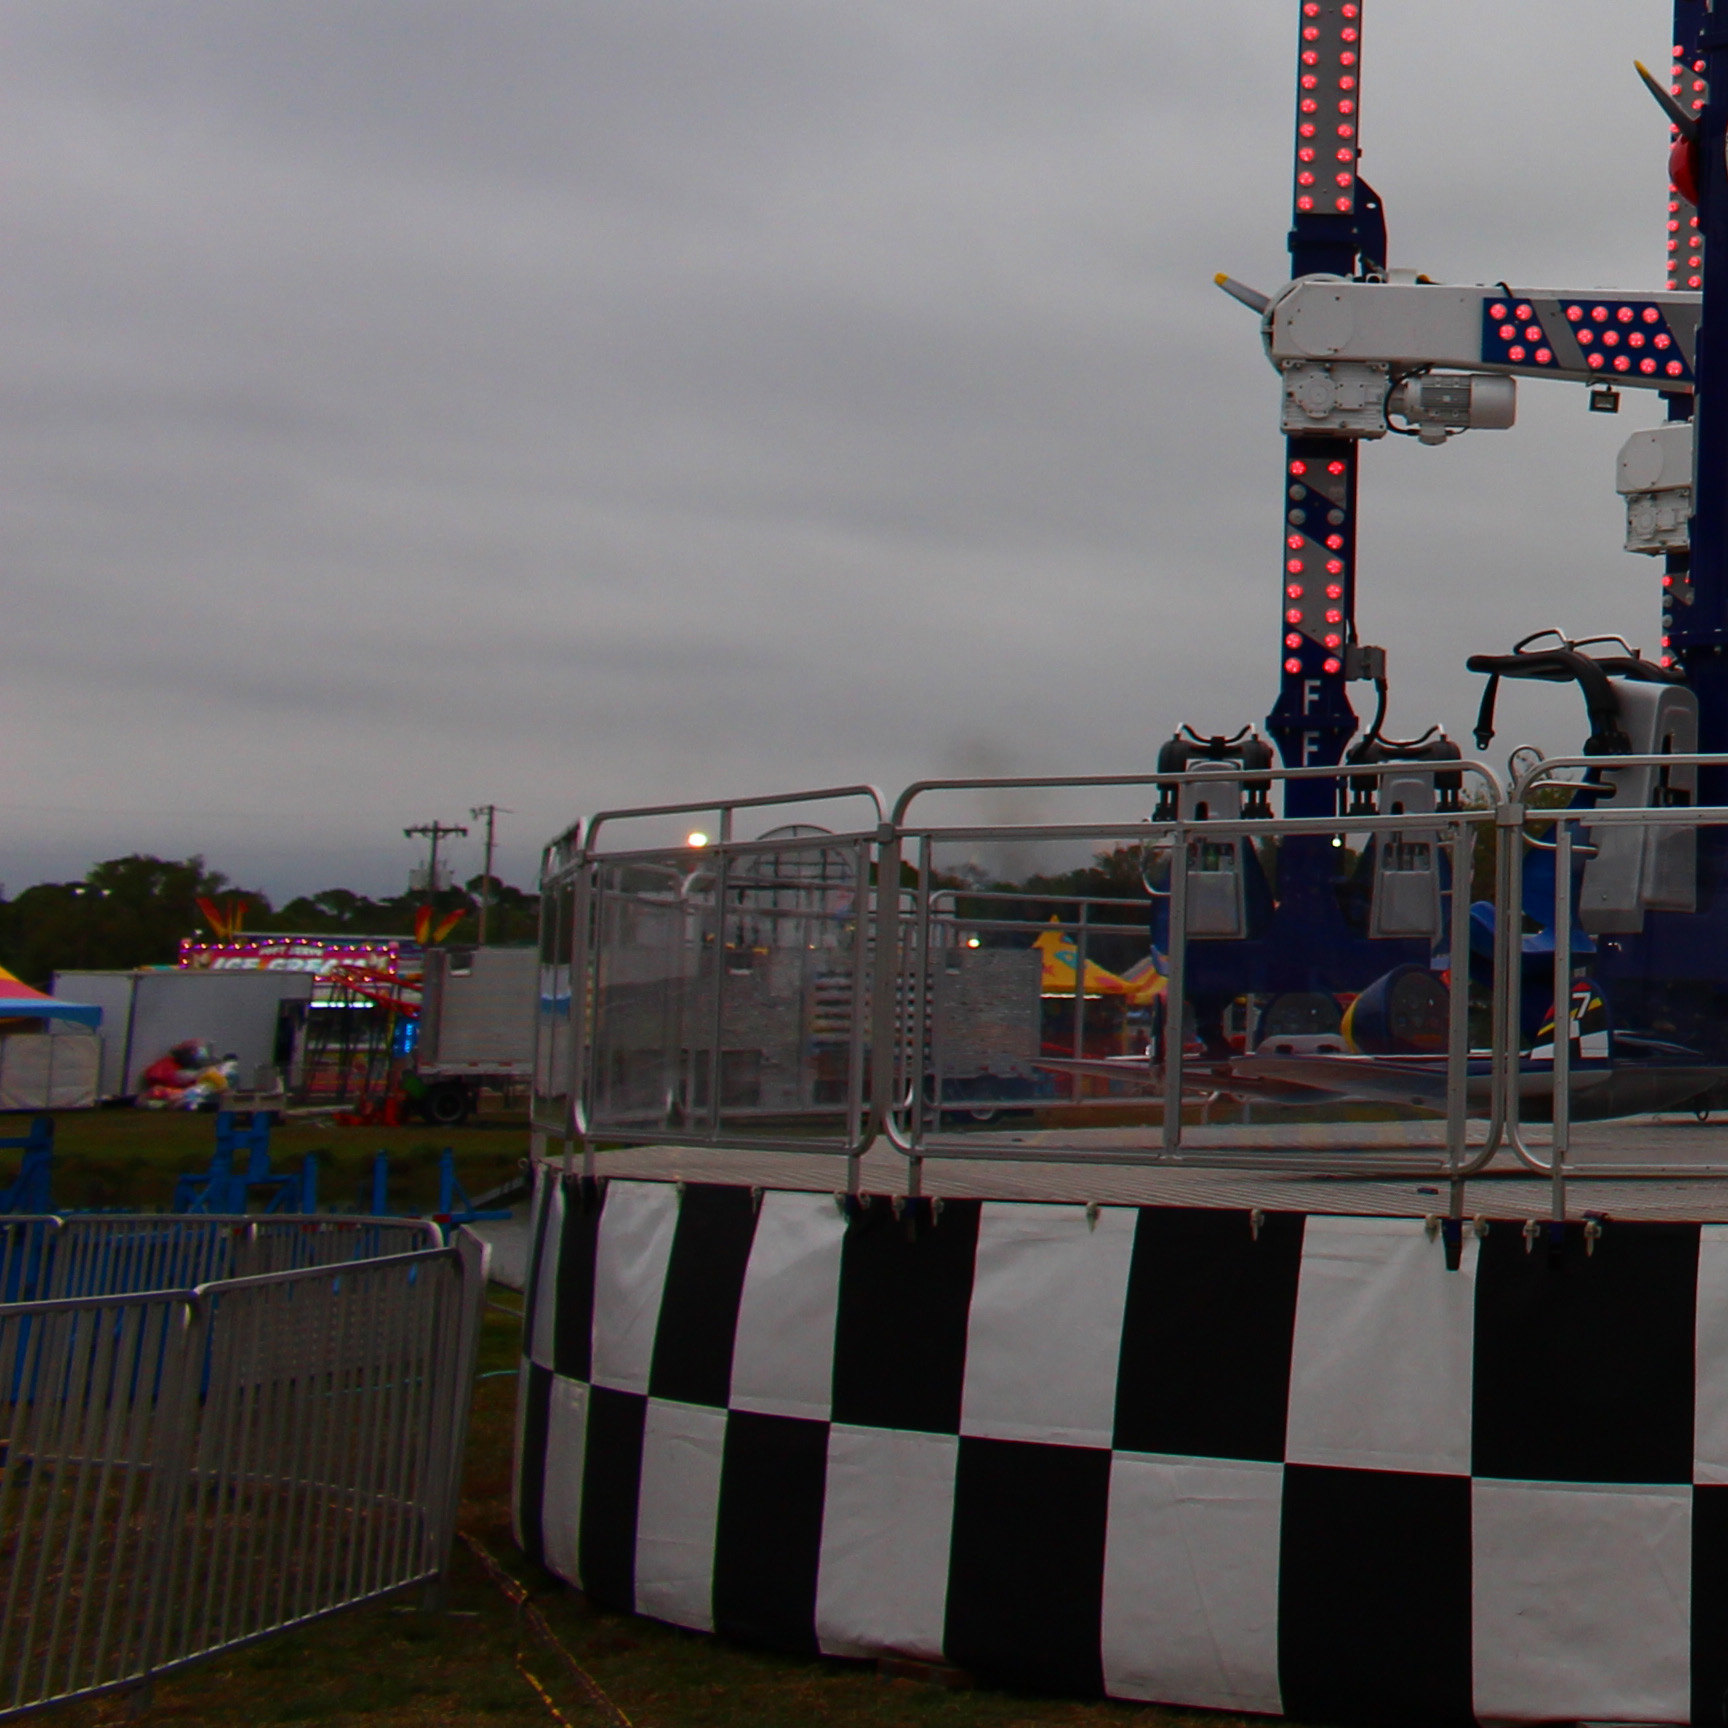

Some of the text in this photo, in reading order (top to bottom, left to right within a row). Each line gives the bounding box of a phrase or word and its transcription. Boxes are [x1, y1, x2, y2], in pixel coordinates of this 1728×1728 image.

[1302, 679, 1322, 716] F
[1302, 730, 1320, 767] F
[1571, 991, 1592, 1020] 7
